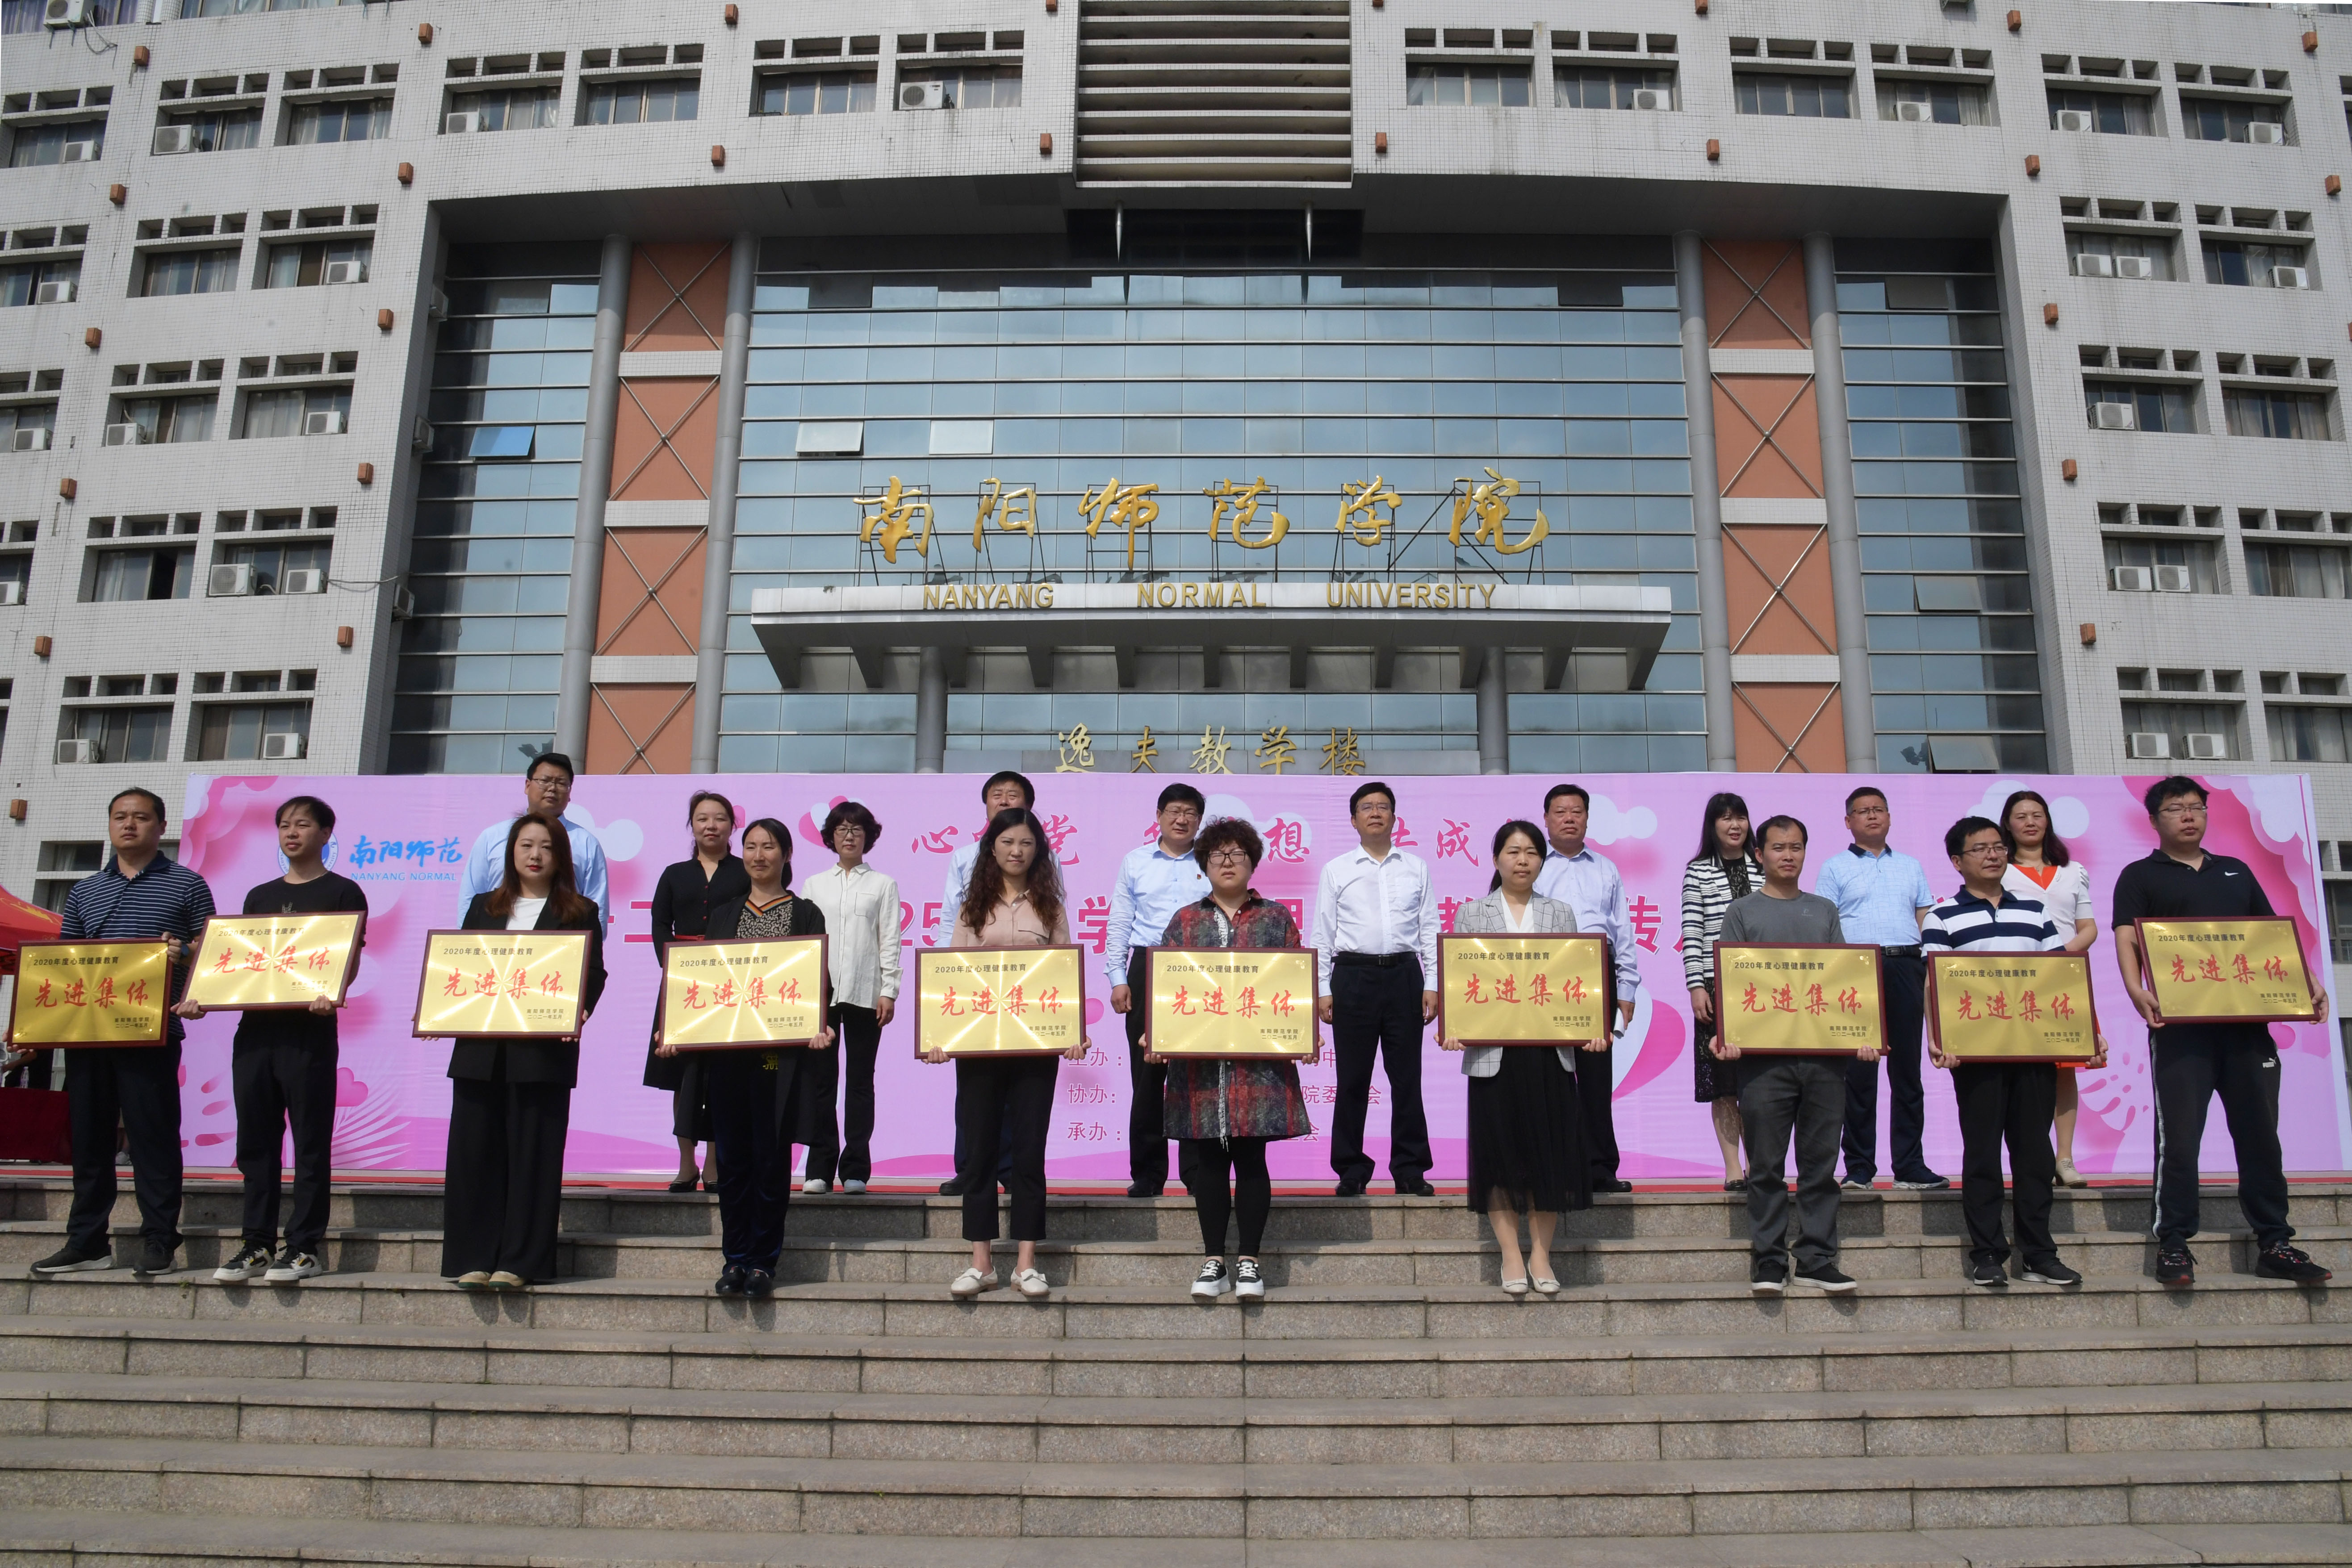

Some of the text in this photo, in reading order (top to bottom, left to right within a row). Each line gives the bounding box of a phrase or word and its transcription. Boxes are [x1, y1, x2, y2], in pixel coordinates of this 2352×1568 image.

[853, 467, 1550, 571] 南阳师范学院
[923, 582, 1496, 610] NANYANG NORMAL UNIVERSITY
[1055, 722, 1365, 776] 逸夫教学楼
[351, 872, 457, 881] NANYANG NORMAL
[443, 948, 533, 956] 2020年度心理健康教育
[2158, 933, 2245, 942] 2020年度心理健康教育
[33, 956, 119, 966] 2020年度心理健康教育
[213, 945, 331, 974] 先进集体
[679, 956, 769, 967] 2020年度心理健康教育
[935, 963, 1027, 974] 2020年度心理健康教育
[1167, 965, 1260, 974] 2020年度心理健康教育
[1458, 952, 1550, 960] 2020年度心理健康教育
[1734, 962, 1825, 970] 2020年度心理健康教育
[2171, 953, 2289, 985] 先进集体
[444, 968, 564, 1000] 先进集体
[1949, 969, 2037, 978] 2020年度心理健康教育
[35, 977, 149, 1009] 先进集体
[683, 977, 802, 1009] 先进集体
[940, 984, 1063, 1017] 先进集体
[1171, 985, 1295, 1019] 先进集体
[1464, 973, 1587, 1007] 先进集体
[1741, 982, 1862, 1016] 先进集体
[1957, 990, 2075, 1023] 先进集体
